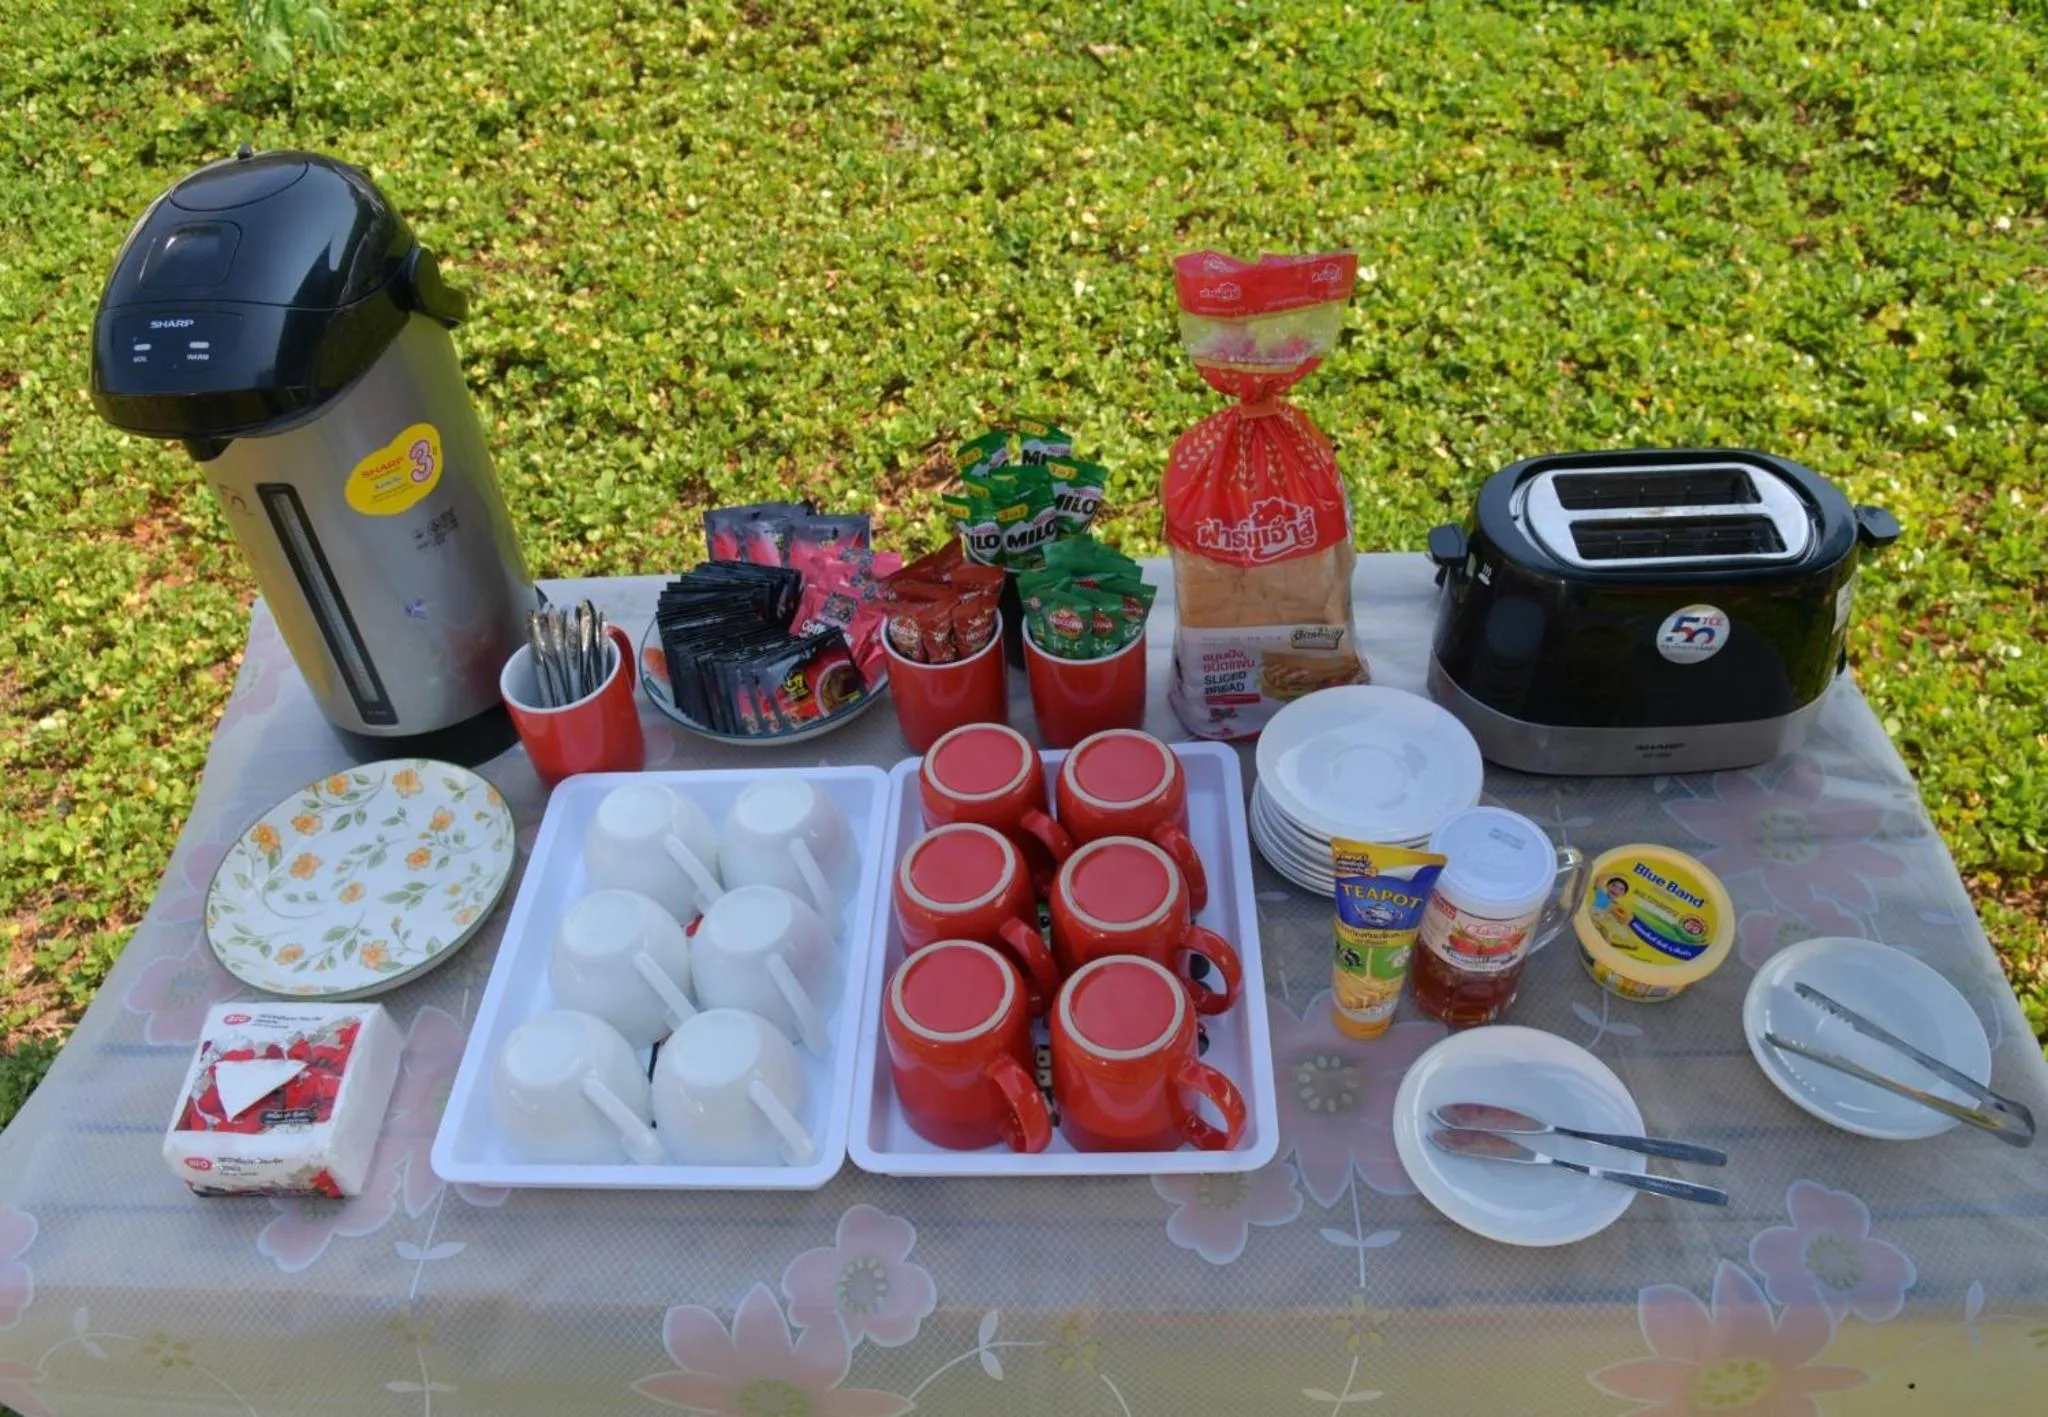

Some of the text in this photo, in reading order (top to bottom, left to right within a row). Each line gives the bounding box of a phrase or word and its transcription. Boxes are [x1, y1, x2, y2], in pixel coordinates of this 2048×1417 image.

[149, 319, 194, 329] SHARP
[360, 456, 404, 478] SHARP
[970, 533, 1000, 551] ILO
[1006, 520, 1057, 549] MILO
[1204, 671, 1247, 686] SLICED
[1205, 682, 1245, 695] BREAD
[1633, 862, 1667, 887] Blue
[1666, 881, 1705, 908] Band
[1340, 882, 1424, 909] TEAPOT
